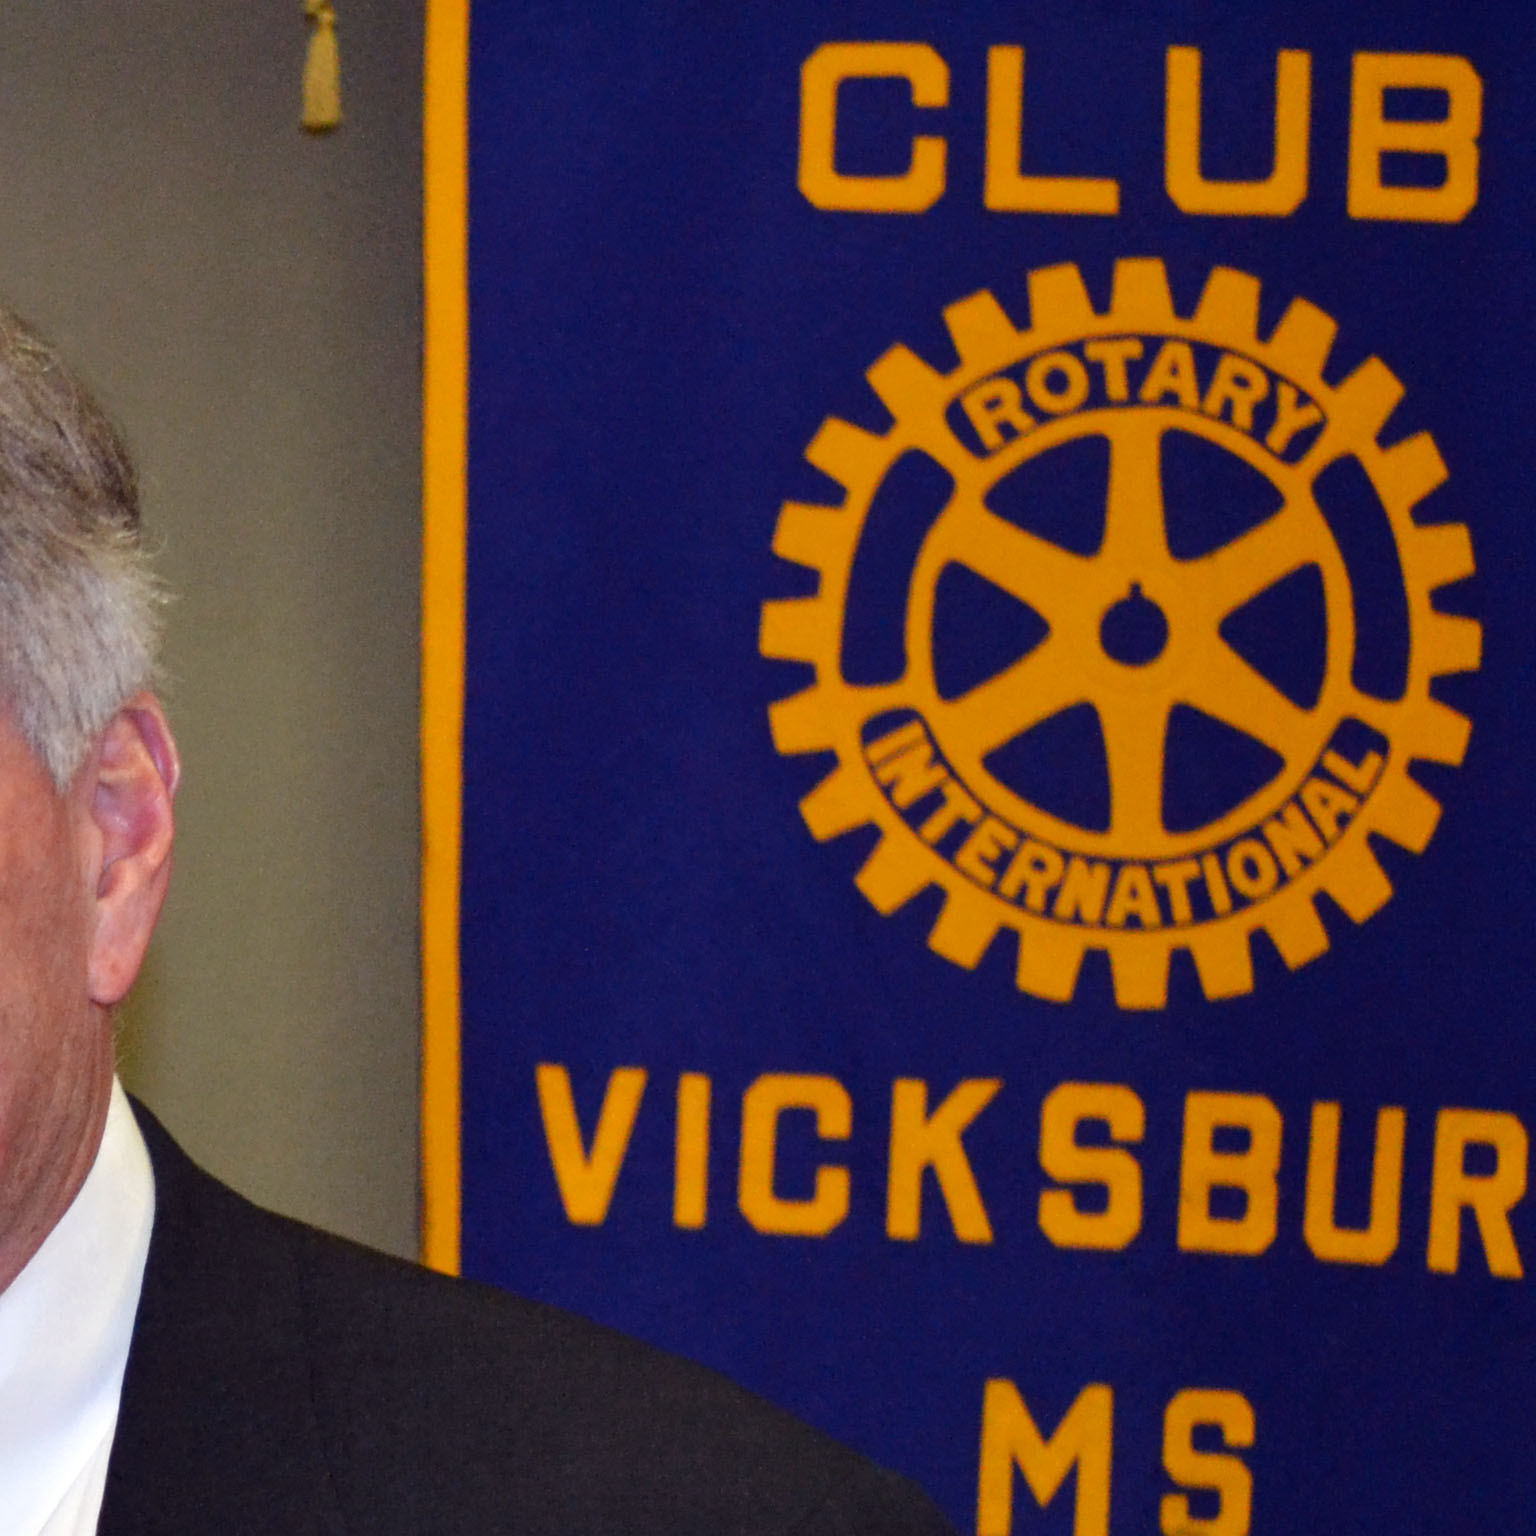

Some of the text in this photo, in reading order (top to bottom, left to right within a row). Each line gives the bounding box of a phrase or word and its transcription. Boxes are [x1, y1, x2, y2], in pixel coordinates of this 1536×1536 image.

[796, 41, 1484, 224] CLUB
[959, 338, 1325, 455] ROTARY
[864, 718, 1385, 928] INTERNATIONAL
